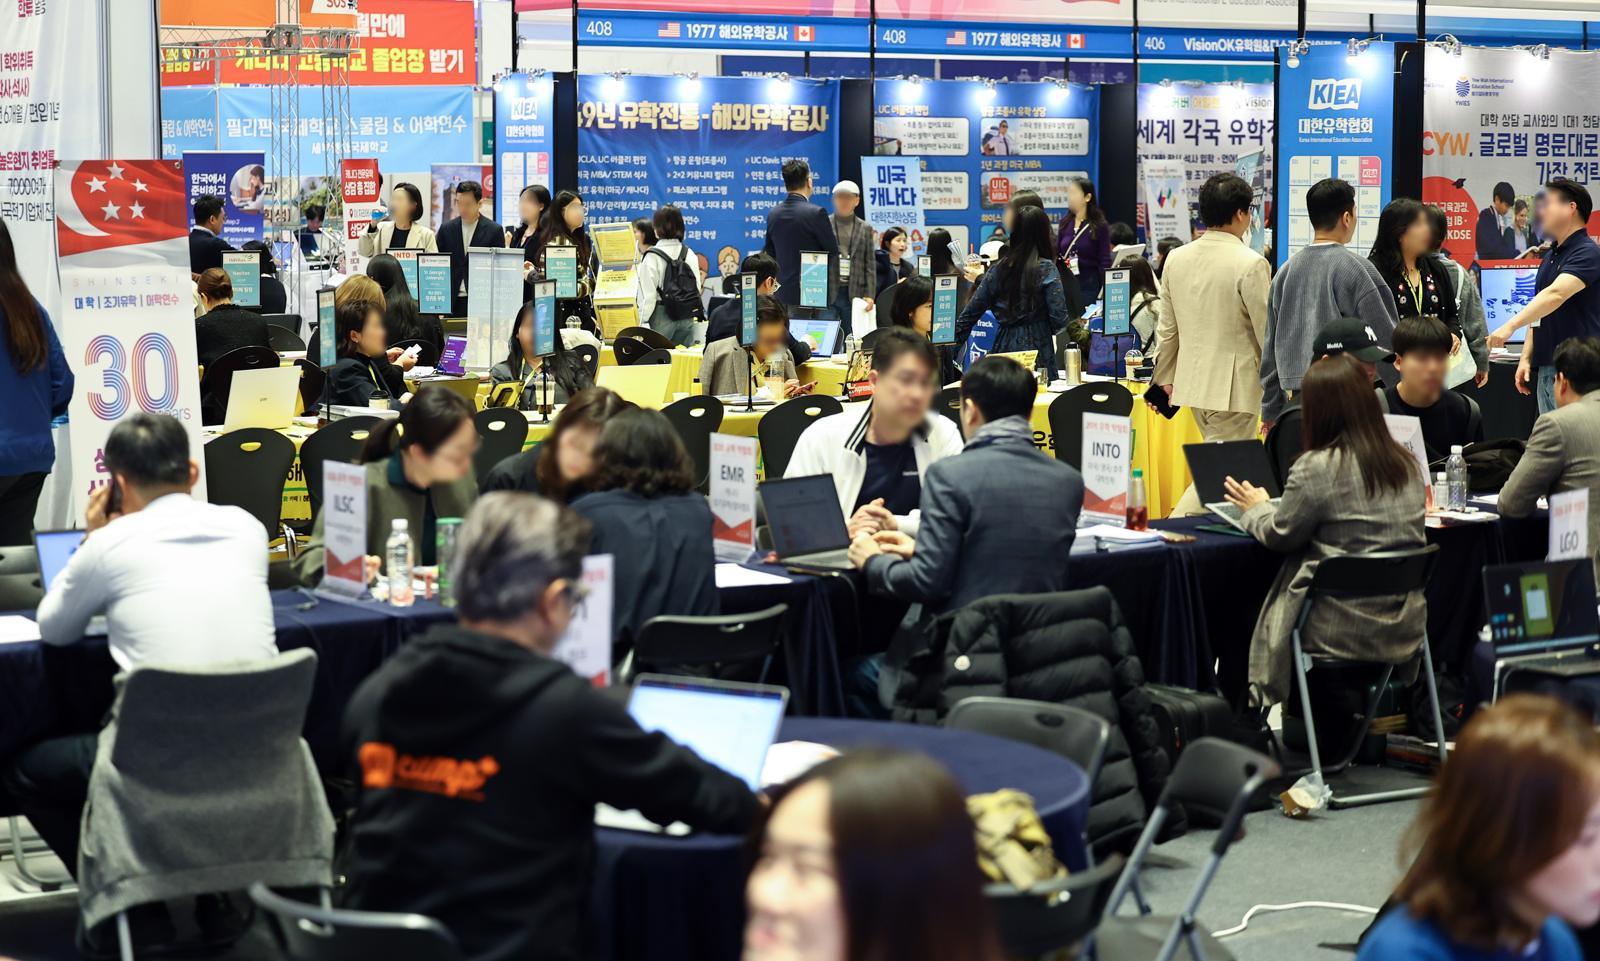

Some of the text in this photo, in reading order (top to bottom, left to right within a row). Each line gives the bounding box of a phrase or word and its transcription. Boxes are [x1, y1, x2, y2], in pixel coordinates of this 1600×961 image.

[586, 21, 612, 36] 408
[686, 22, 788, 41] 1977 해외유학공사
[882, 30, 906, 44] 408
[971, 31, 1062, 48] 1977 해외유학공사
[1144, 36, 1166, 51] 406
[372, 47, 425, 74] 졸업장
[428, 48, 464, 74] 받기
[1313, 82, 1359, 105] KIEA
[29, 101, 49, 122] 편입
[618, 100, 700, 130] 유학전통
[711, 101, 830, 132] 해외유학공사
[1480, 113, 1498, 127] 대학
[1502, 114, 1520, 127] 상담
[1523, 114, 1558, 128] 교사와의
[1563, 115, 1579, 128] 1대1
[226, 117, 273, 137] 필리핀
[345, 116, 388, 135] 스쿨링
[393, 118, 404, 133] &
[409, 114, 467, 134] 어학연수
[1137, 119, 1175, 144] 세계
[1183, 119, 1221, 146] 각국
[1298, 117, 1374, 134] 대한유학협회
[1479, 132, 1528, 157] 글로벌
[1535, 133, 1599, 157] 명문대로
[598, 155, 610, 164] UC
[191, 172, 227, 185] 한국에서
[877, 165, 906, 184] 미국
[991, 179, 1007, 188] UIC
[191, 184, 227, 197] 준비하고
[869, 187, 917, 206] 캐나다
[871, 210, 917, 224] 대학진학상담
[104, 296, 137, 309] 조기유학
[85, 332, 179, 421] 30
[1092, 441, 1121, 459] INTO
[720, 464, 745, 483] EMR
[333, 494, 355, 514] ILSC
[1560, 531, 1578, 553] LGO
